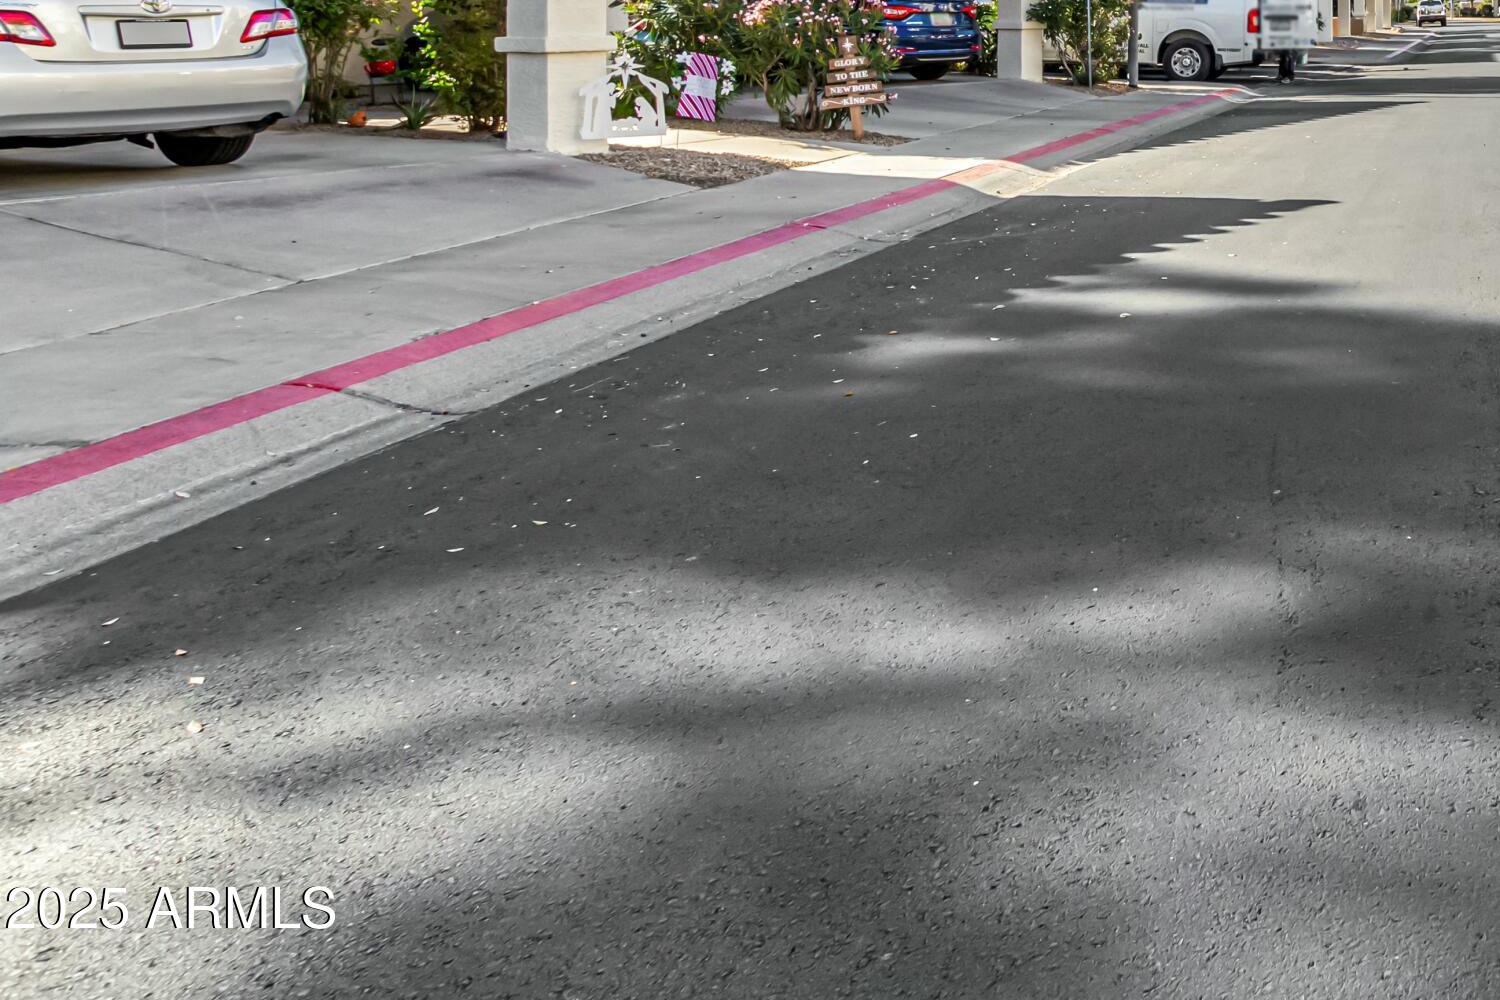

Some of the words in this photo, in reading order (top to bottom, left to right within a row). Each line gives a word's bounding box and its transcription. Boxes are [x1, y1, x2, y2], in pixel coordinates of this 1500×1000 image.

[834, 57, 866, 67] GLORY
[849, 70, 868, 79] THE
[830, 83, 878, 94] NEWBORN
[843, 96, 866, 105] KING
